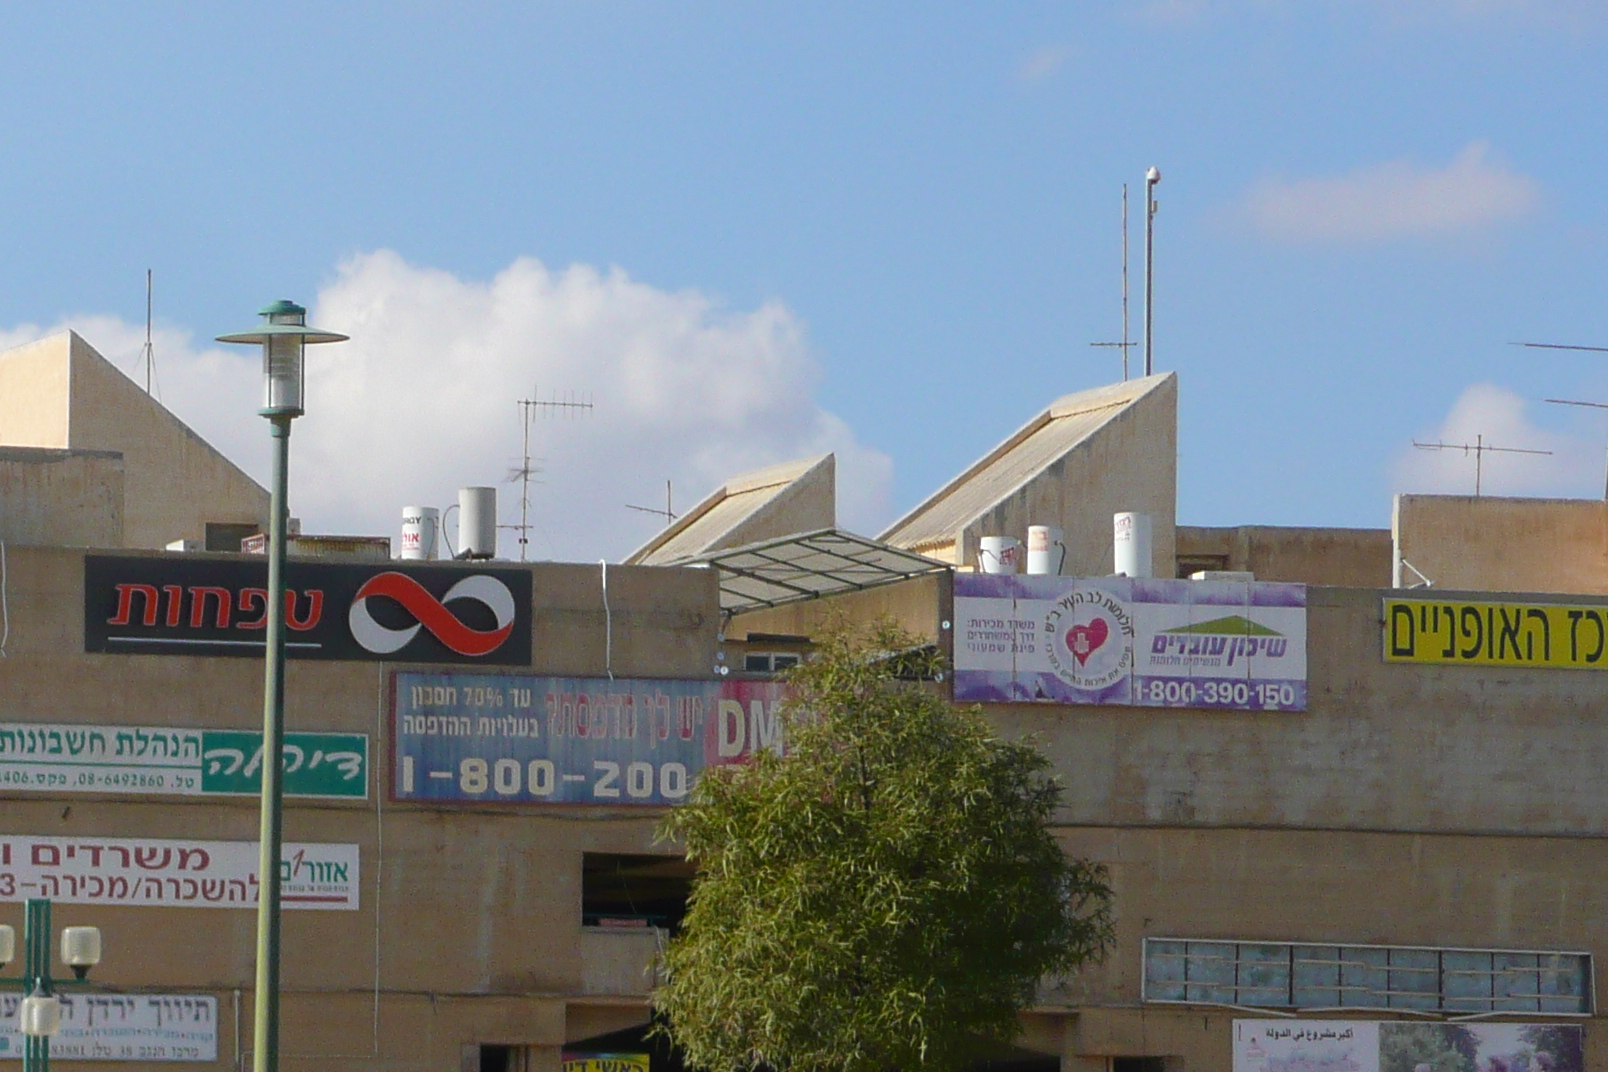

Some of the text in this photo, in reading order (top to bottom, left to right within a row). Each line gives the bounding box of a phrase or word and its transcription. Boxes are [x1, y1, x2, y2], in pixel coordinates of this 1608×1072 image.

[107, 582, 324, 631] טפחות
[1391, 603, 1550, 662] האופניים
[1151, 634, 1288, 667] שיכון עובדים
[411, 685, 457, 709] חסכון
[509, 687, 531, 708] עד
[1134, 680, 1295, 706] 1-800-390-150
[402, 714, 539, 738] בעלויות ההדפסה
[115, 727, 200, 759] הנהלת
[31, 844, 210, 872] משרדים
[87, 998, 135, 1027] ירדן
[148, 998, 209, 1027] תיווך
